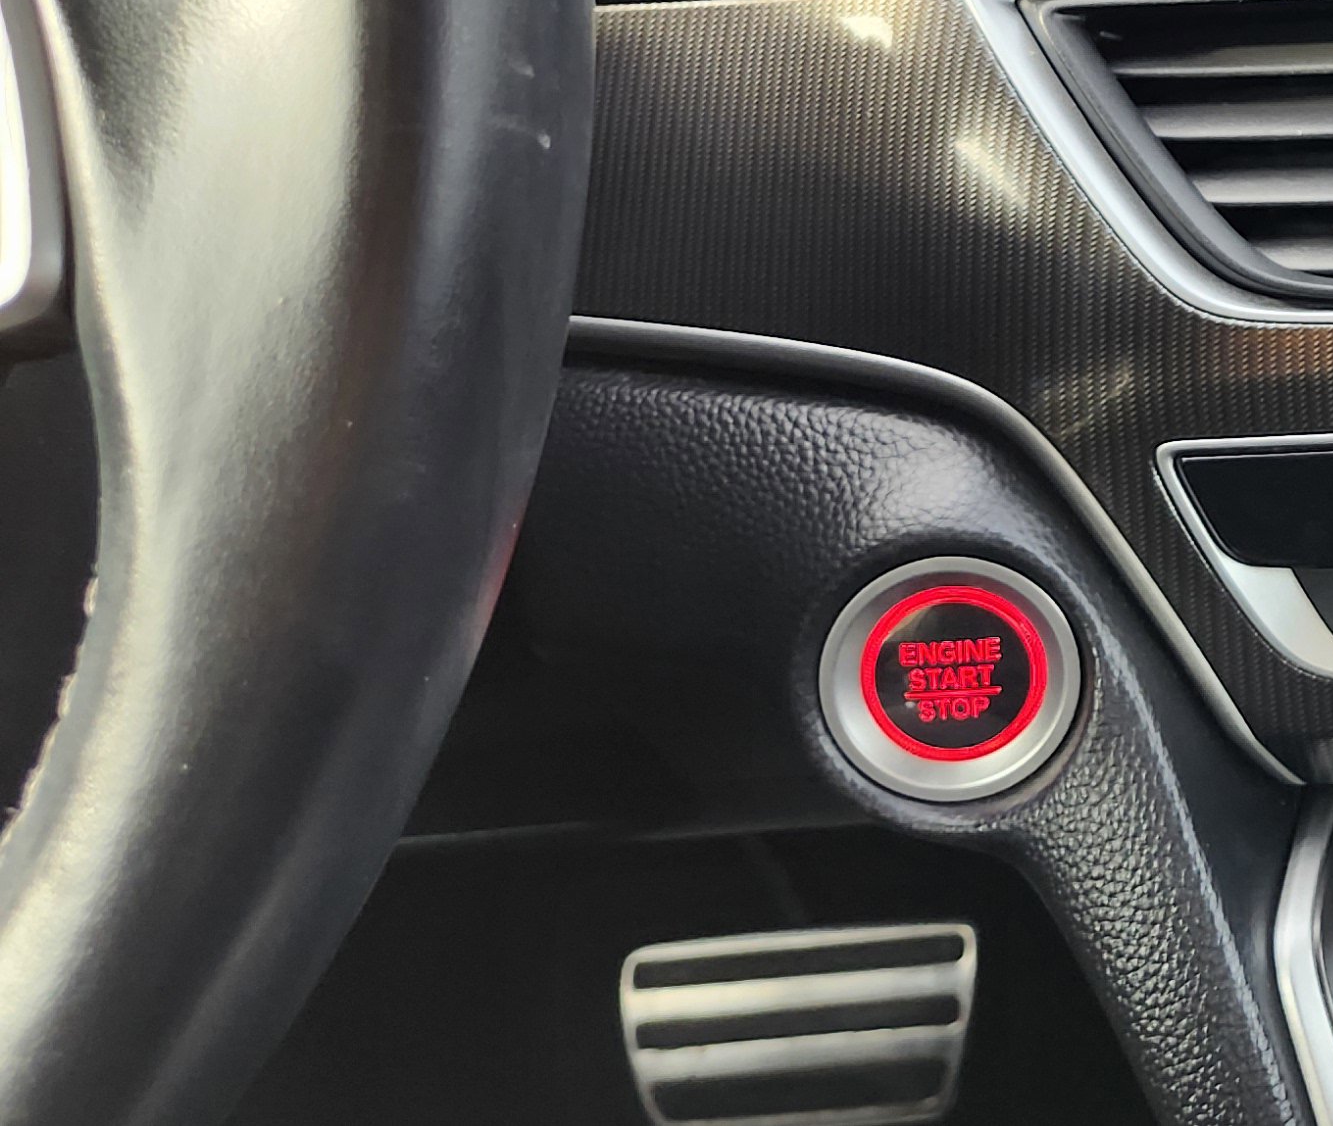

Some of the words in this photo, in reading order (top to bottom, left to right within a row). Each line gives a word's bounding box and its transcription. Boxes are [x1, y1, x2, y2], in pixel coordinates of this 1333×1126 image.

[898, 636, 1002, 666] ENGINE
[908, 664, 995, 691] START
[917, 696, 990, 722] STOP
